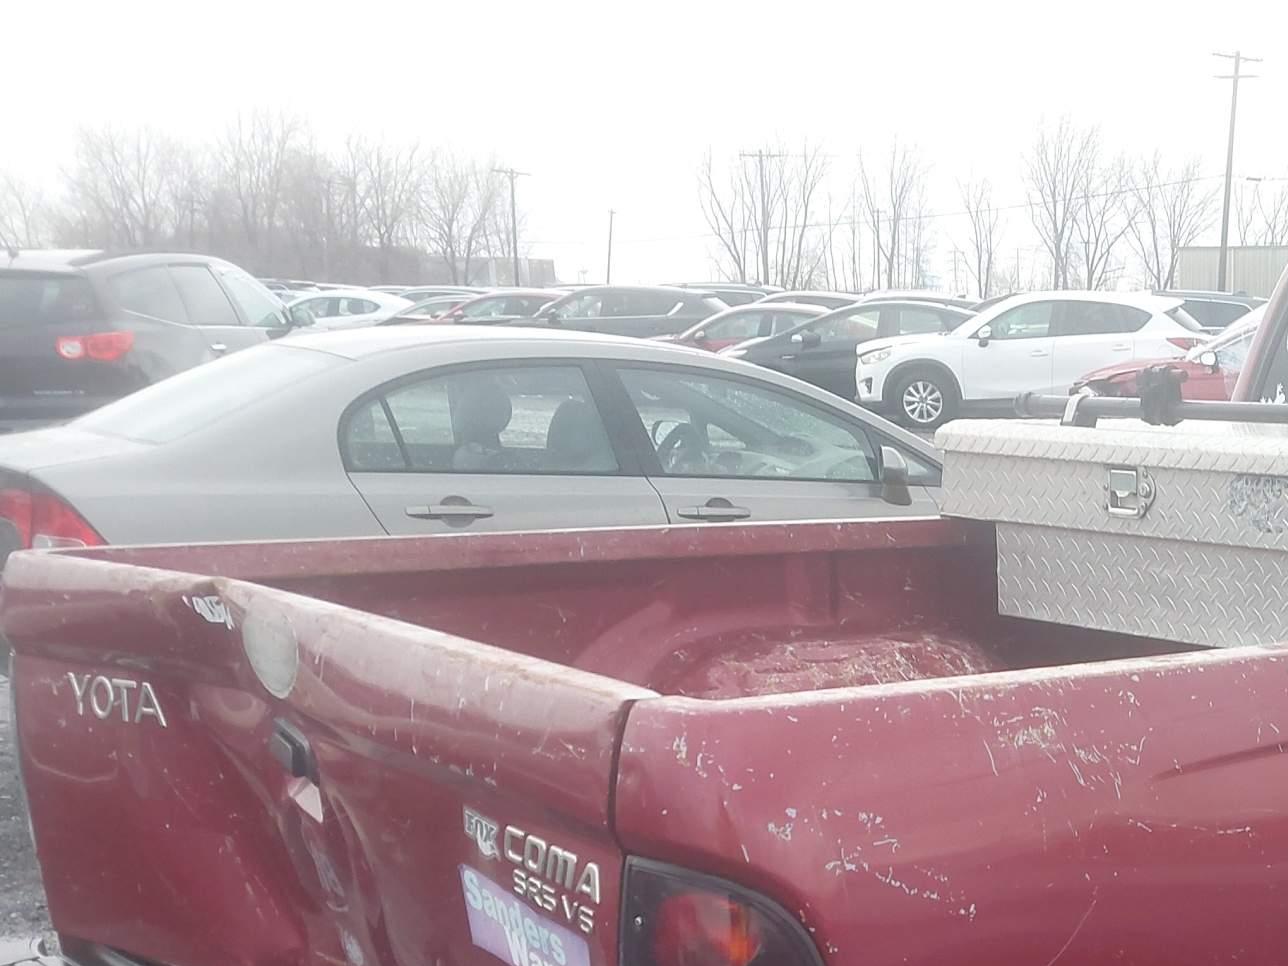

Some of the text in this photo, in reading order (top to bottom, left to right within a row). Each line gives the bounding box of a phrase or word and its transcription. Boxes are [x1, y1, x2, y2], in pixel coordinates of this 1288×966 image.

[66, 671, 168, 729] YOTA
[504, 824, 601, 905] COMA
[463, 869, 568, 966] Sanders
